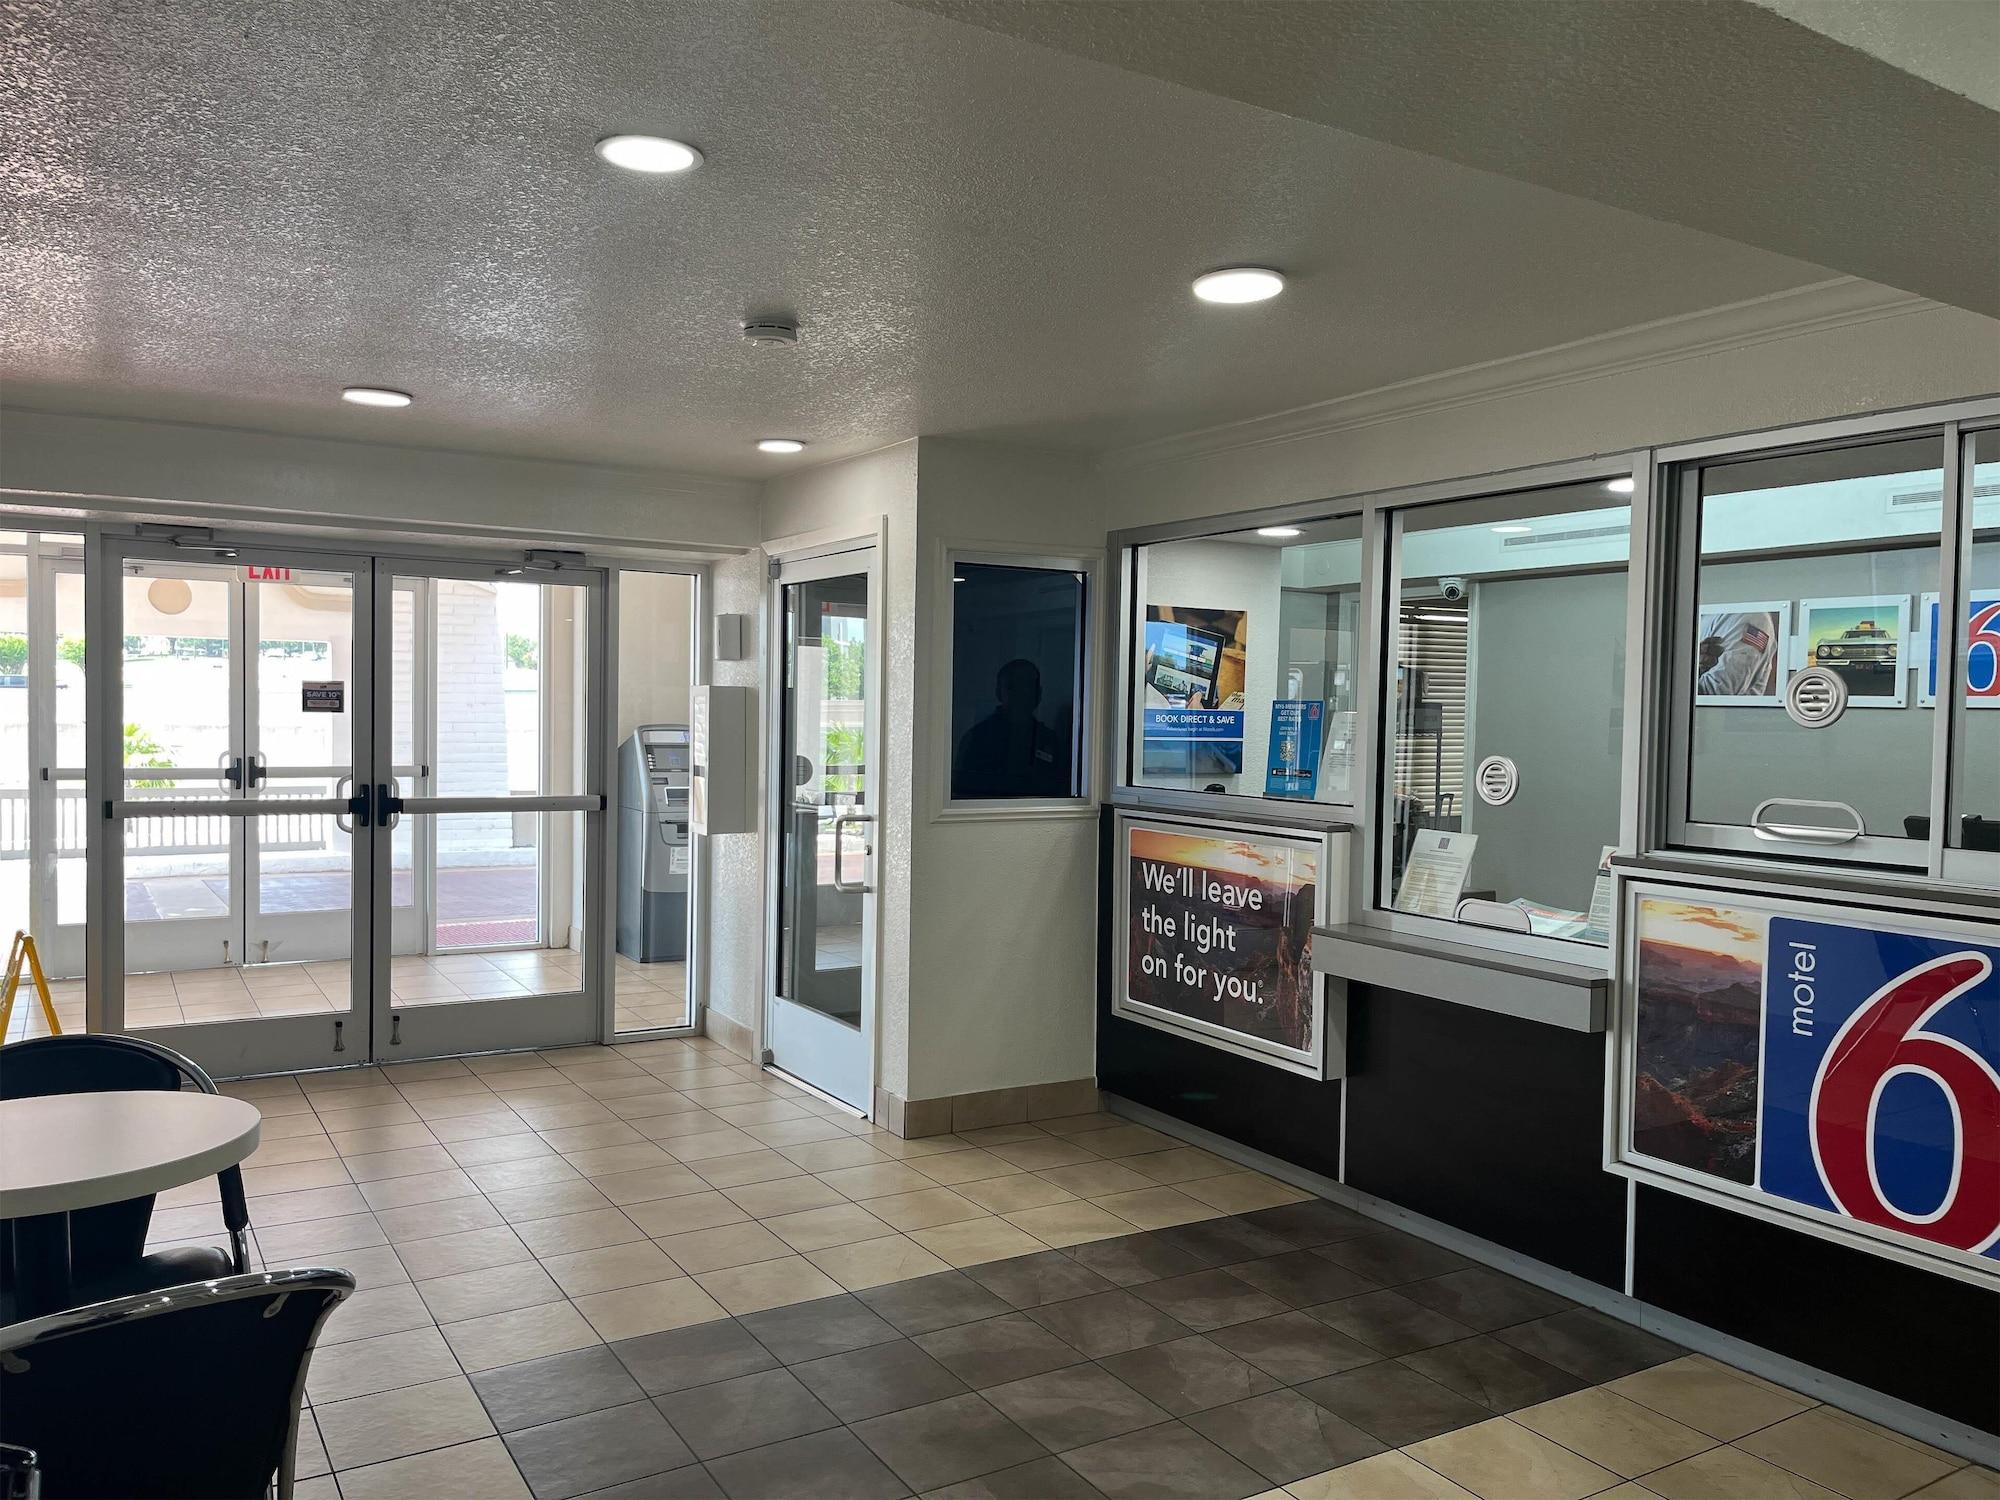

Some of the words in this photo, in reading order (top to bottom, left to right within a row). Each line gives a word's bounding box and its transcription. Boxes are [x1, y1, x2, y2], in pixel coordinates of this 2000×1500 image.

[1155, 714, 1179, 723] BOOK
[1180, 715, 1208, 724] DIRECT
[1208, 716, 1215, 724] &
[1216, 716, 1235, 724] SAVE
[1141, 862, 1194, 898] We'll
[1202, 870, 1263, 910] leave
[1141, 904, 1177, 937] the
[1184, 911, 1236, 954] light
[1141, 954, 1167, 979] on
[1174, 953, 1207, 988] for
[1788, 941, 1817, 1037] motel
[1808, 950, 2000, 1254] 6
